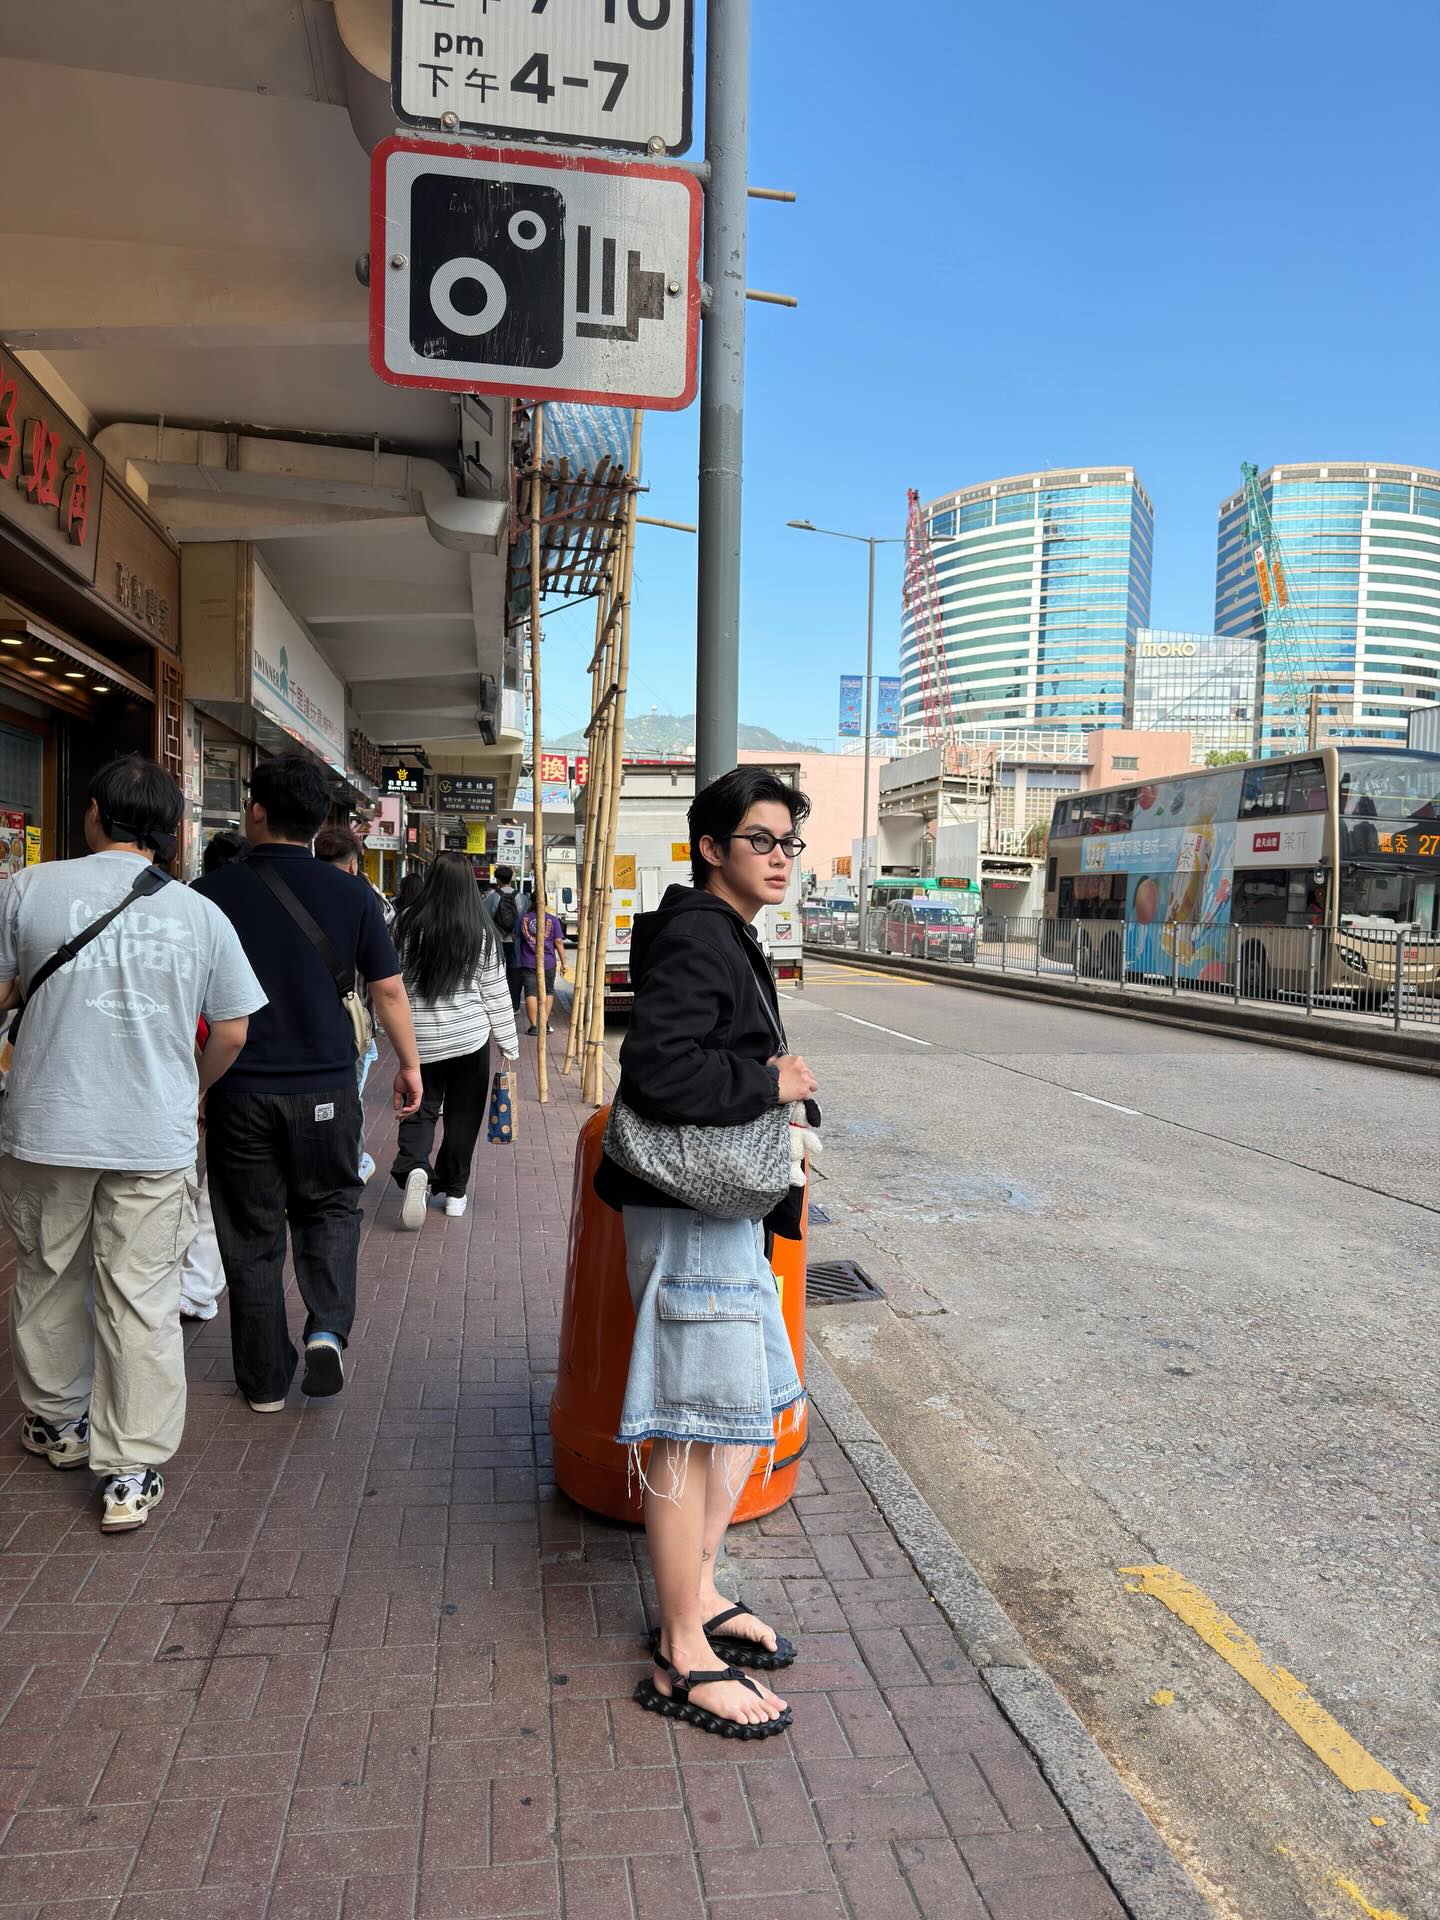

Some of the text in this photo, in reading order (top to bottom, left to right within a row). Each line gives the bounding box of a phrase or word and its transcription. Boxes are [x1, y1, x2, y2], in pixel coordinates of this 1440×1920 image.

[434, 32, 484, 57] pm
[418, 52, 629, 112] 下午 4-7
[1142, 641, 1196, 657] MOKO
[254, 650, 280, 688] TWINNER
[84, 998, 170, 1014] WORLDWIDE
